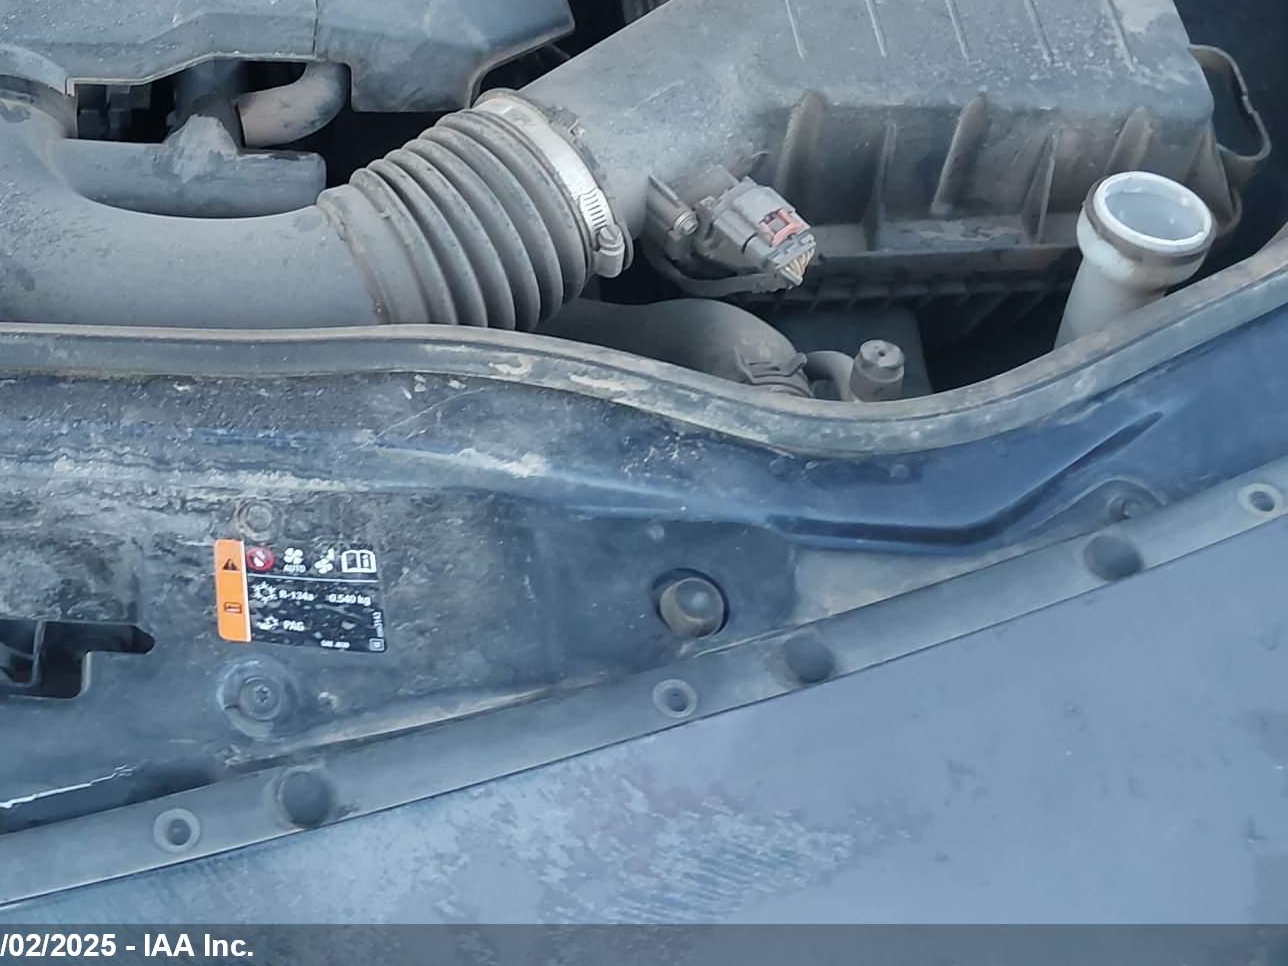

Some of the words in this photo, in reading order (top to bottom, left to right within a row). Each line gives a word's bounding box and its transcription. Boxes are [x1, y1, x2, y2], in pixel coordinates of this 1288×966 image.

[283, 564, 306, 573] AUTO
[279, 590, 315, 601] R-134a
[357, 595, 371, 606] kg
[282, 620, 305, 631] PAG
